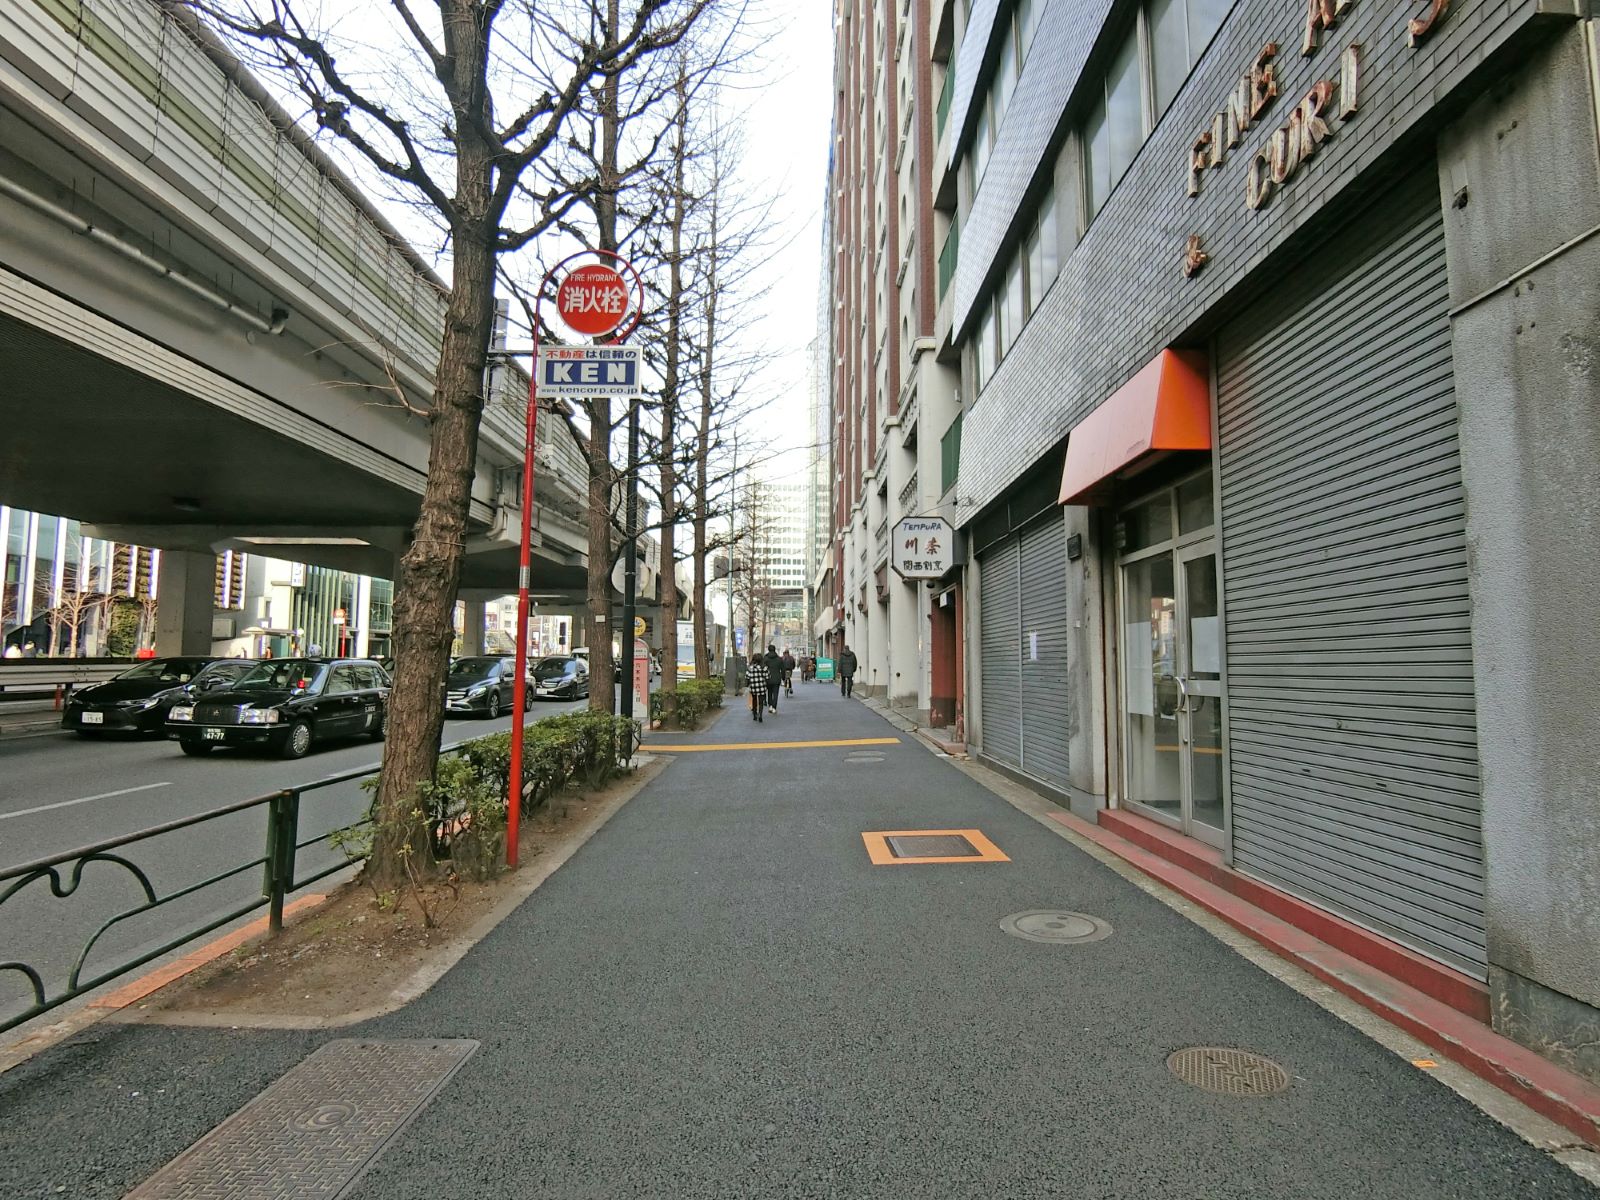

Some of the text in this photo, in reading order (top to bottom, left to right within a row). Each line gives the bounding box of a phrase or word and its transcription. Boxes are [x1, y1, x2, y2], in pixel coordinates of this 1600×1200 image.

[1187, 41, 1278, 198] FINE
[570, 274, 618, 282] FIRE HYDRANT
[563, 286, 624, 314] 消火栓
[546, 350, 637, 359] 不動産は信頼の
[553, 362, 626, 383] KEN
